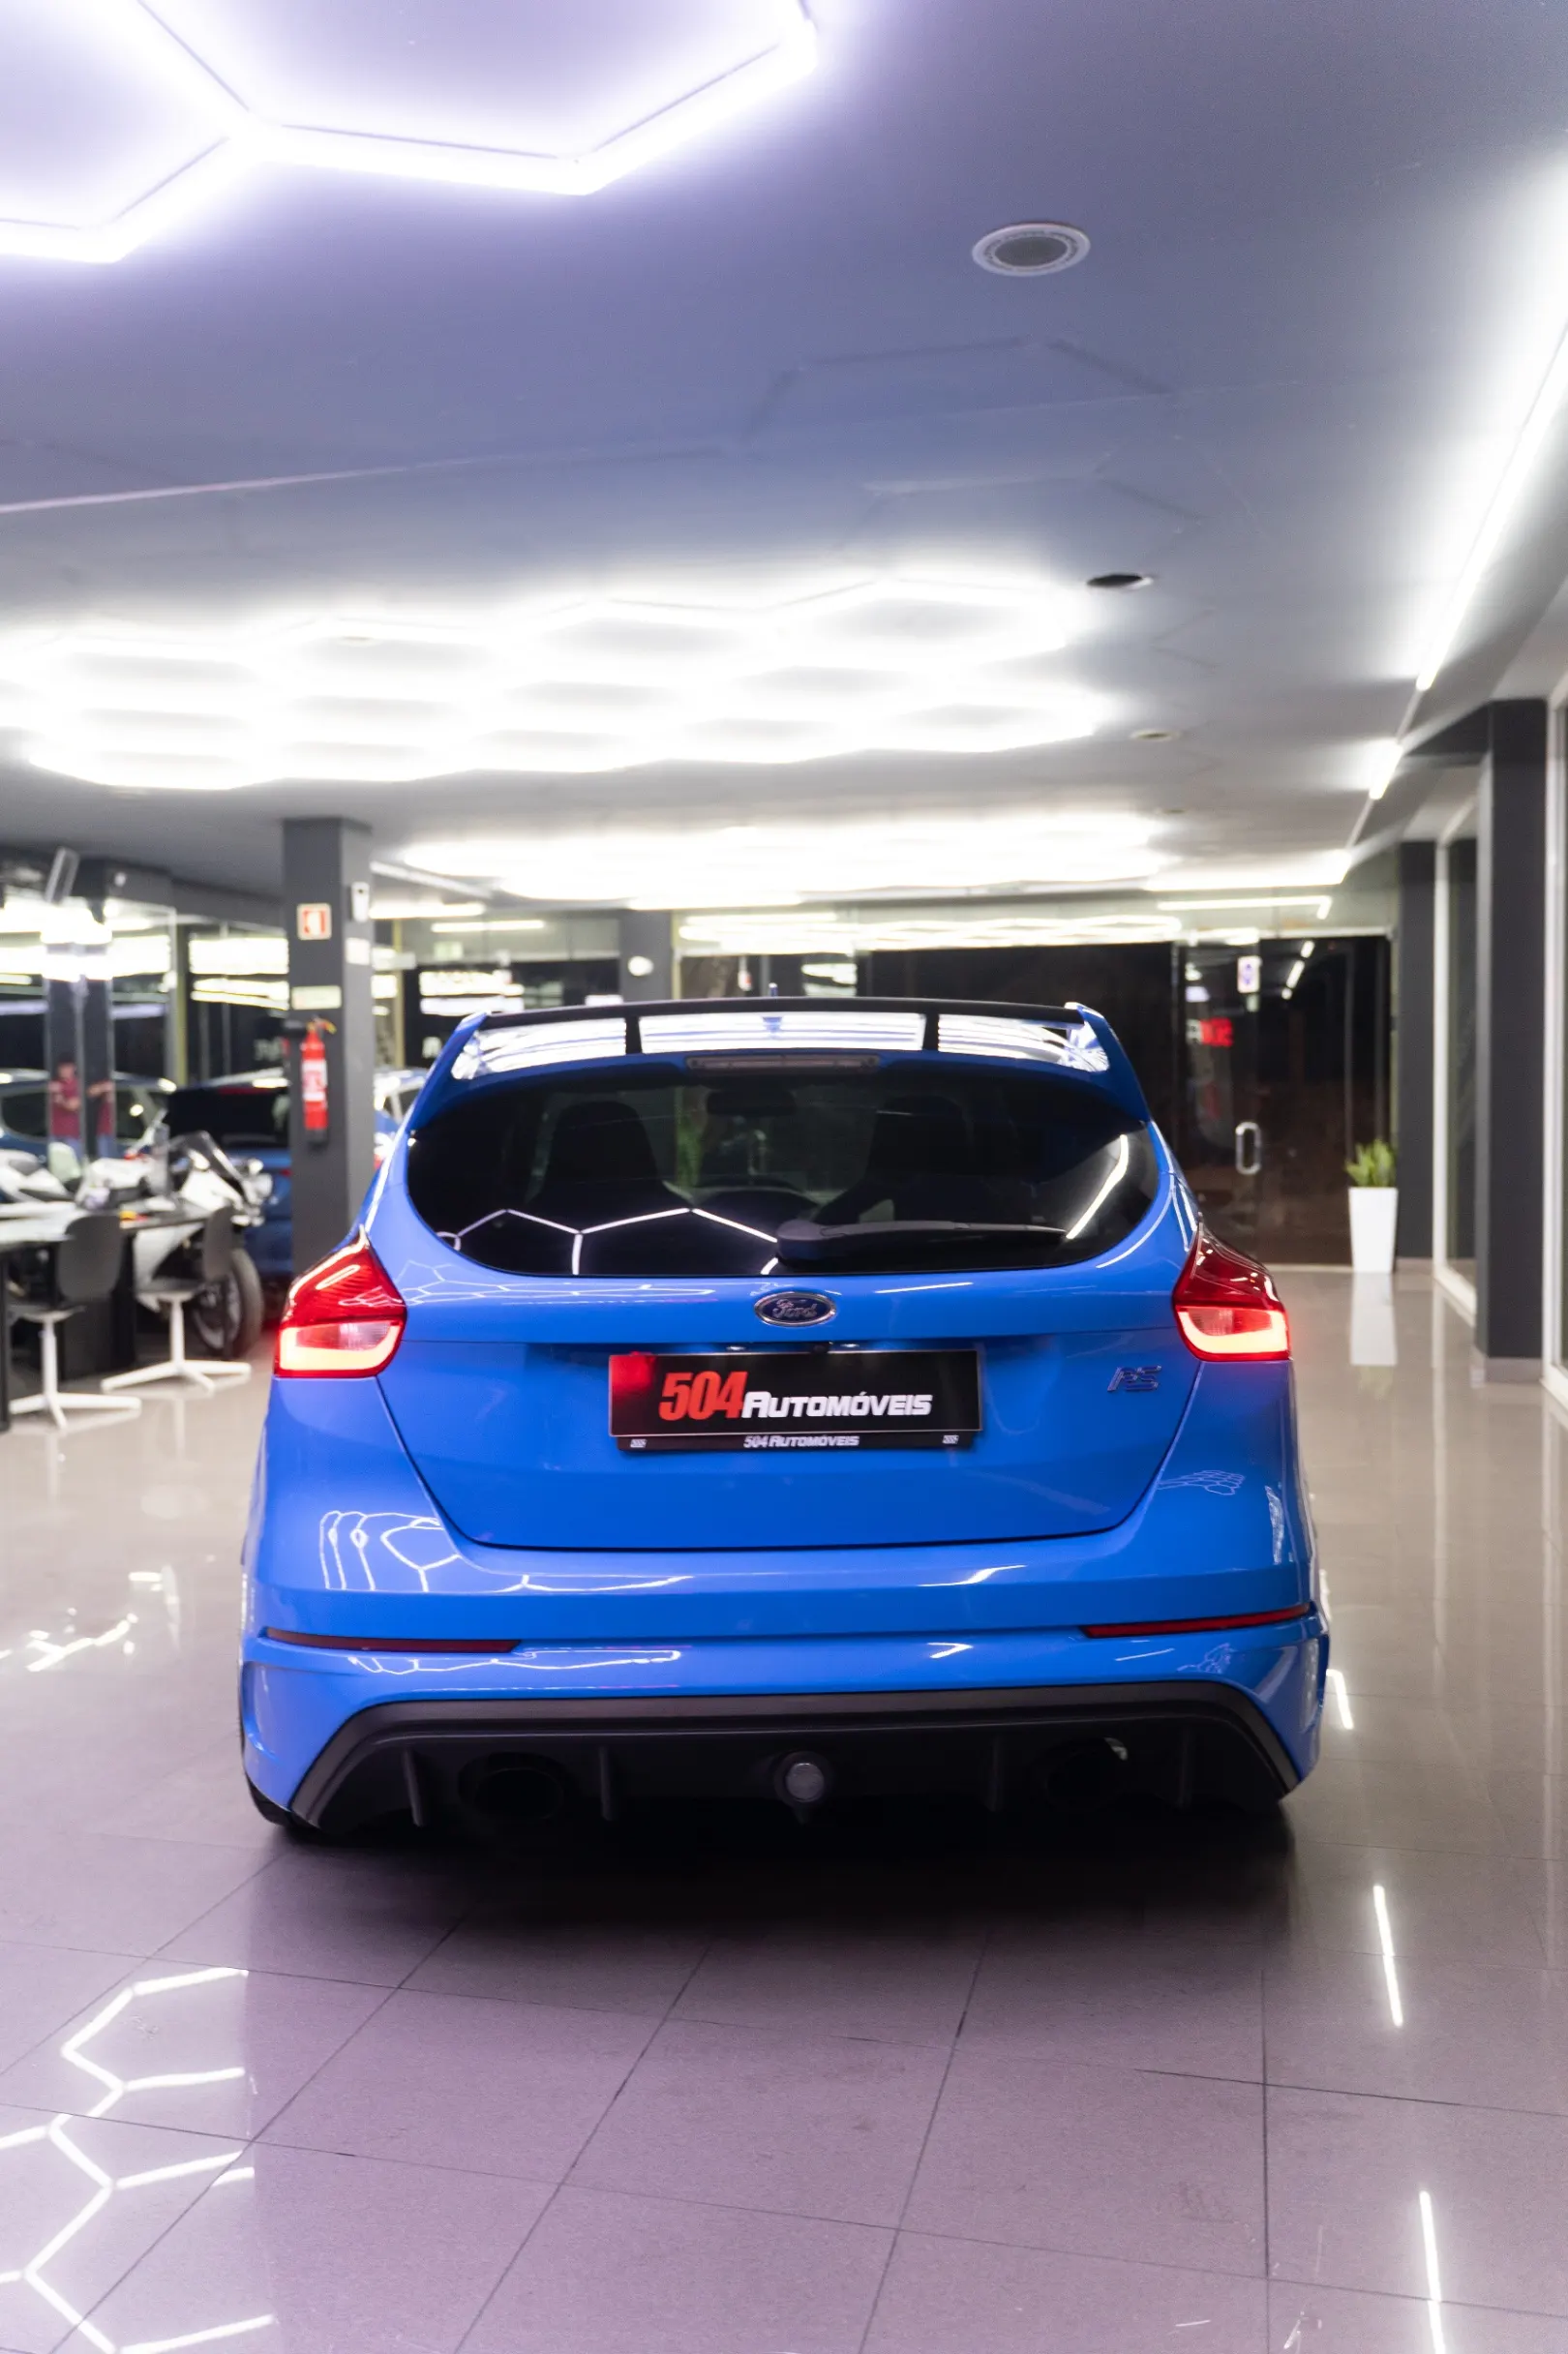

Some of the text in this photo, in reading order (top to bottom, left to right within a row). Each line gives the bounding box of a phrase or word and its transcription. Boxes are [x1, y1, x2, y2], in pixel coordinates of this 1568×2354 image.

[772, 1298, 818, 1318] Ford
[1107, 1365, 1162, 1392] RS
[658, 1371, 748, 1421] 504
[743, 1435, 769, 1448] 504
